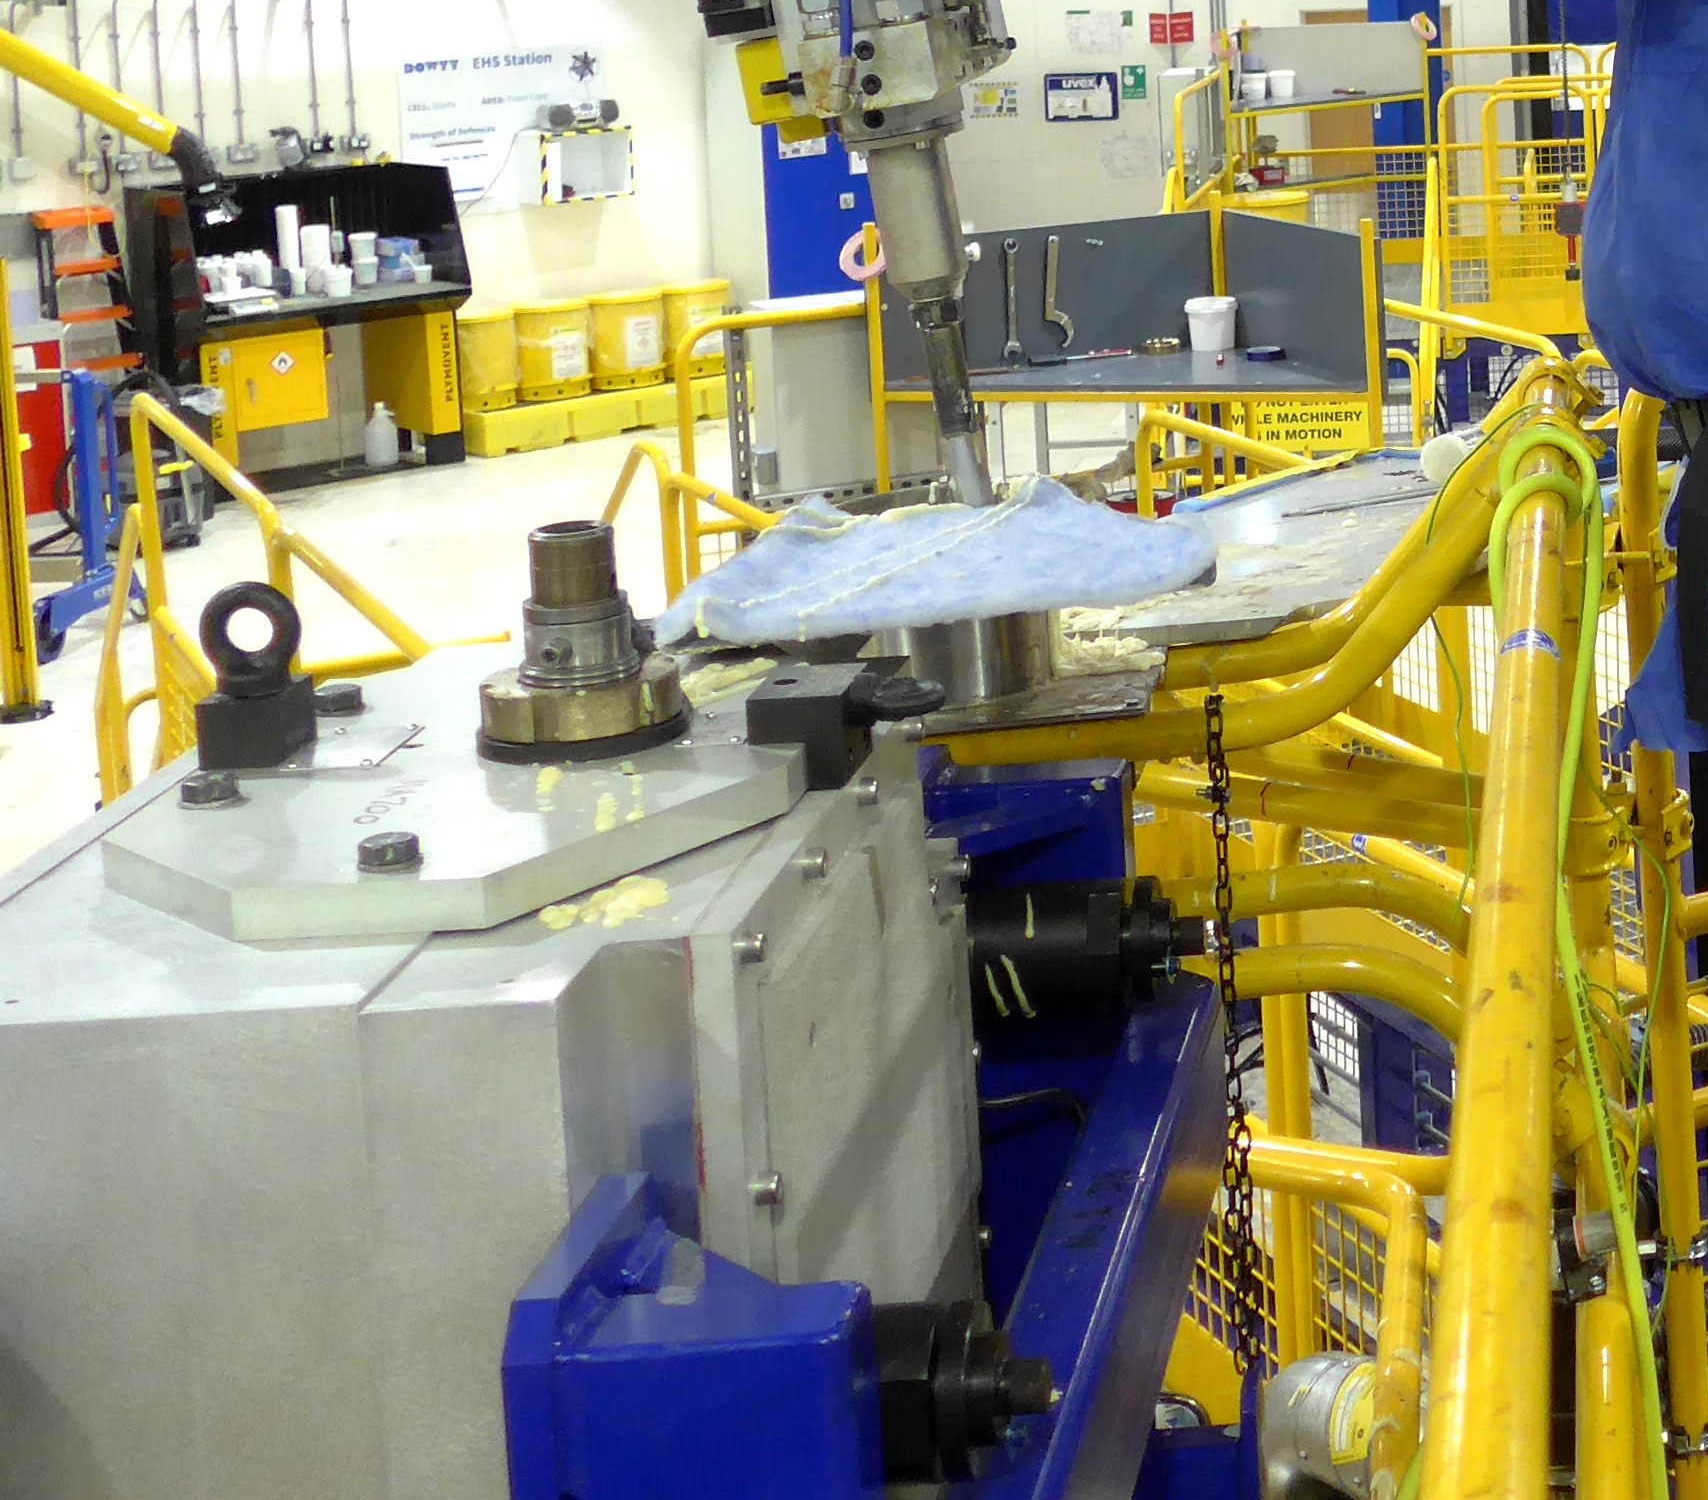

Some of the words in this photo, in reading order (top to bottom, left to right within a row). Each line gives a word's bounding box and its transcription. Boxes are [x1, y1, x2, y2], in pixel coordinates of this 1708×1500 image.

[472, 56, 500, 70] EHS
[503, 52, 552, 67] Station
[1062, 78, 1095, 90] uvex
[448, 127, 457, 136] of
[439, 323, 455, 403] PLYMOVENT
[207, 355, 223, 440] PLYENT
[1277, 411, 1363, 424] MACHINERY
[1266, 430, 1280, 442] IN
[1285, 428, 1342, 441] MOTION
